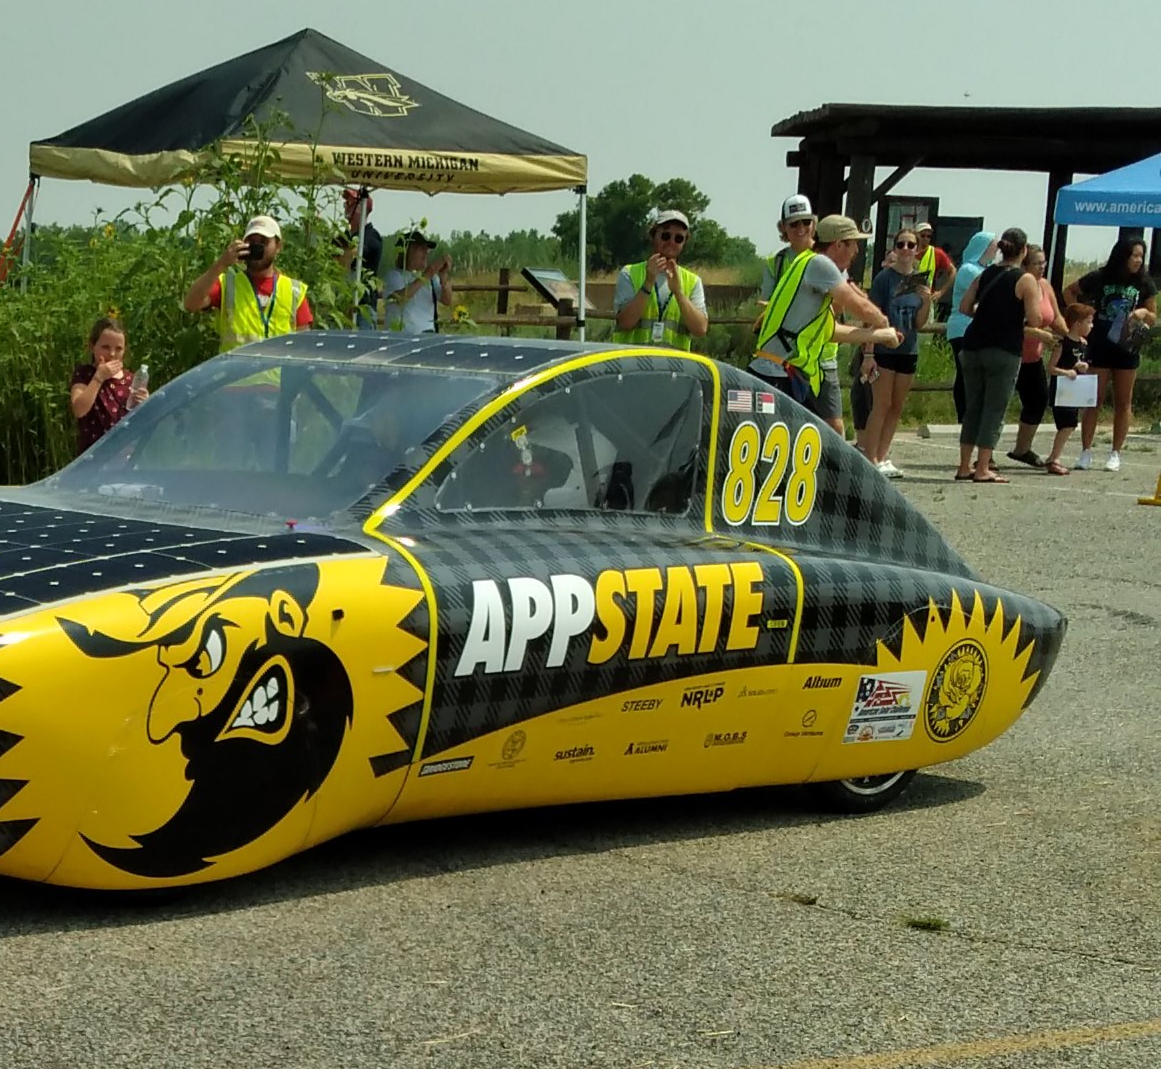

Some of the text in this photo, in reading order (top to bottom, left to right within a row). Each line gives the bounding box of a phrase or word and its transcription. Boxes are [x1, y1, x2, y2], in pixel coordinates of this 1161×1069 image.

[332, 152, 479, 172] WESTERN MICHIGAN
[351, 169, 456, 183] UNIVERSITY
[1074, 201, 1161, 213] www.america
[721, 420, 822, 526] 828
[802, 675, 843, 690] Altium
[621, 699, 663, 712] STEEBY
[634, 744, 668, 755] ALUMNI
